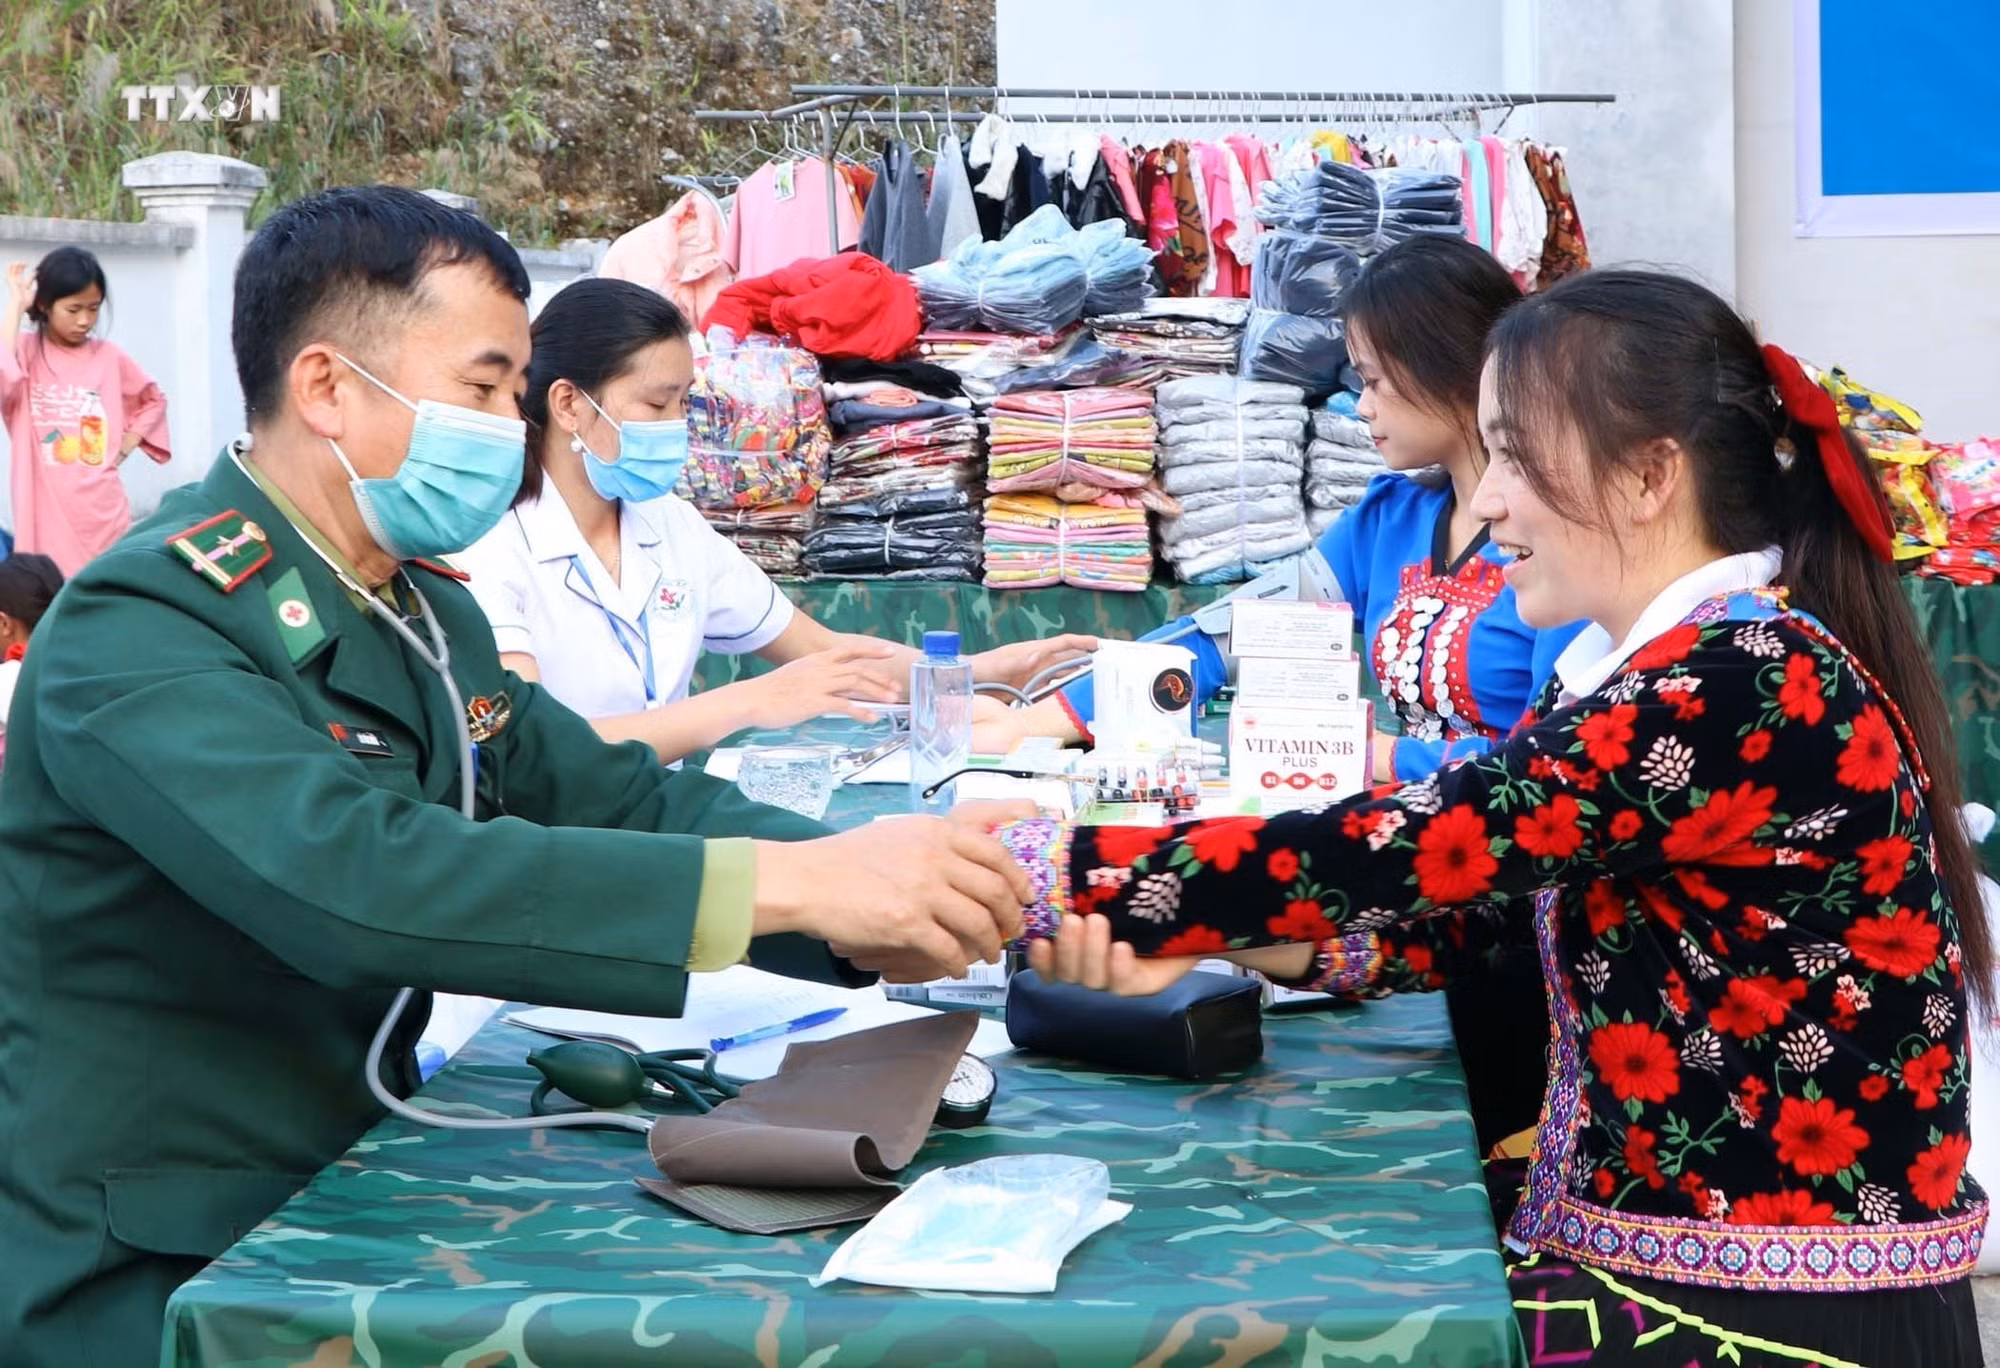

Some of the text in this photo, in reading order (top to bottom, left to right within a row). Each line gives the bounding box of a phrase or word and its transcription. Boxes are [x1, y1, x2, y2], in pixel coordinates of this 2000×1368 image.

[1245, 738, 1354, 755] VITAMIN 3B
[1282, 756, 1318, 768] PLUS
[1318, 776, 1336, 787] B12
